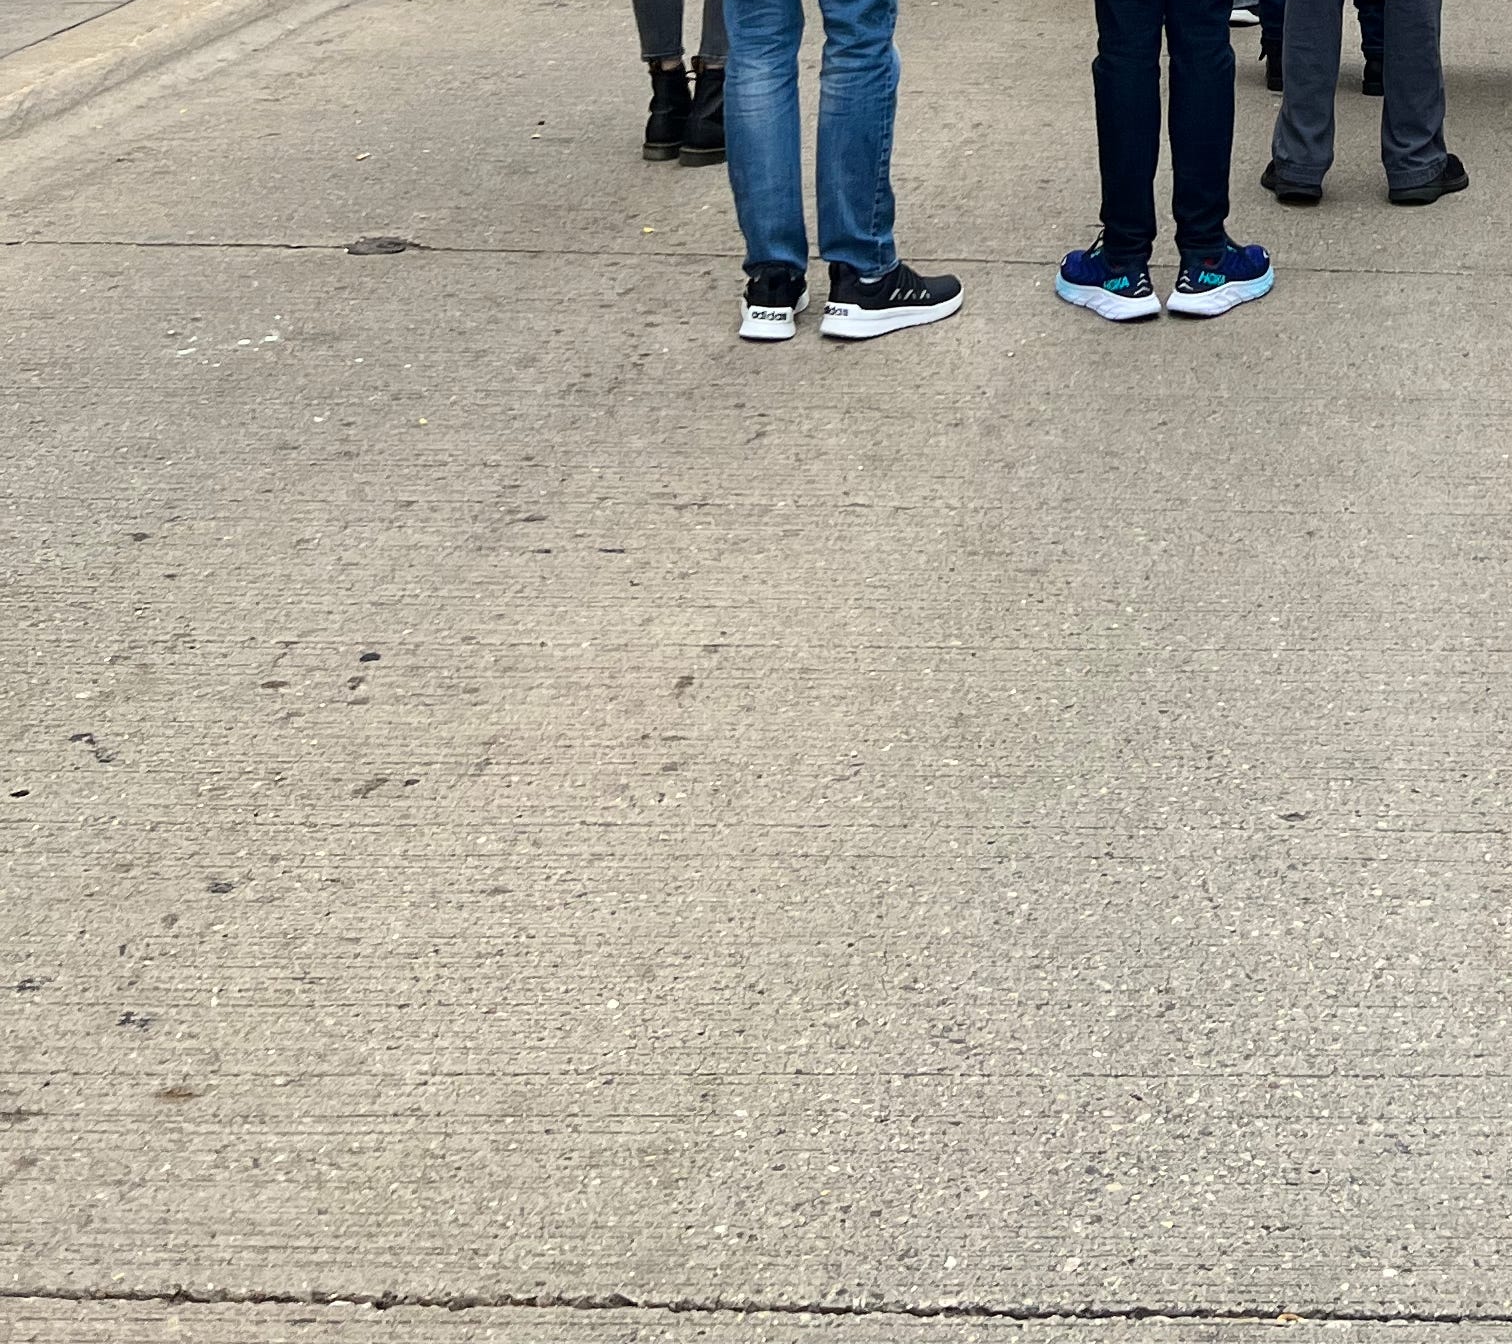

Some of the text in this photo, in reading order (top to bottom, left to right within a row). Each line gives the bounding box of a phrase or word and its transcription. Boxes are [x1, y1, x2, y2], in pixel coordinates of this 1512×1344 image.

[1103, 275, 1130, 291] HOKA
[1198, 270, 1226, 285] HOKA
[751, 310, 787, 321] adidas
